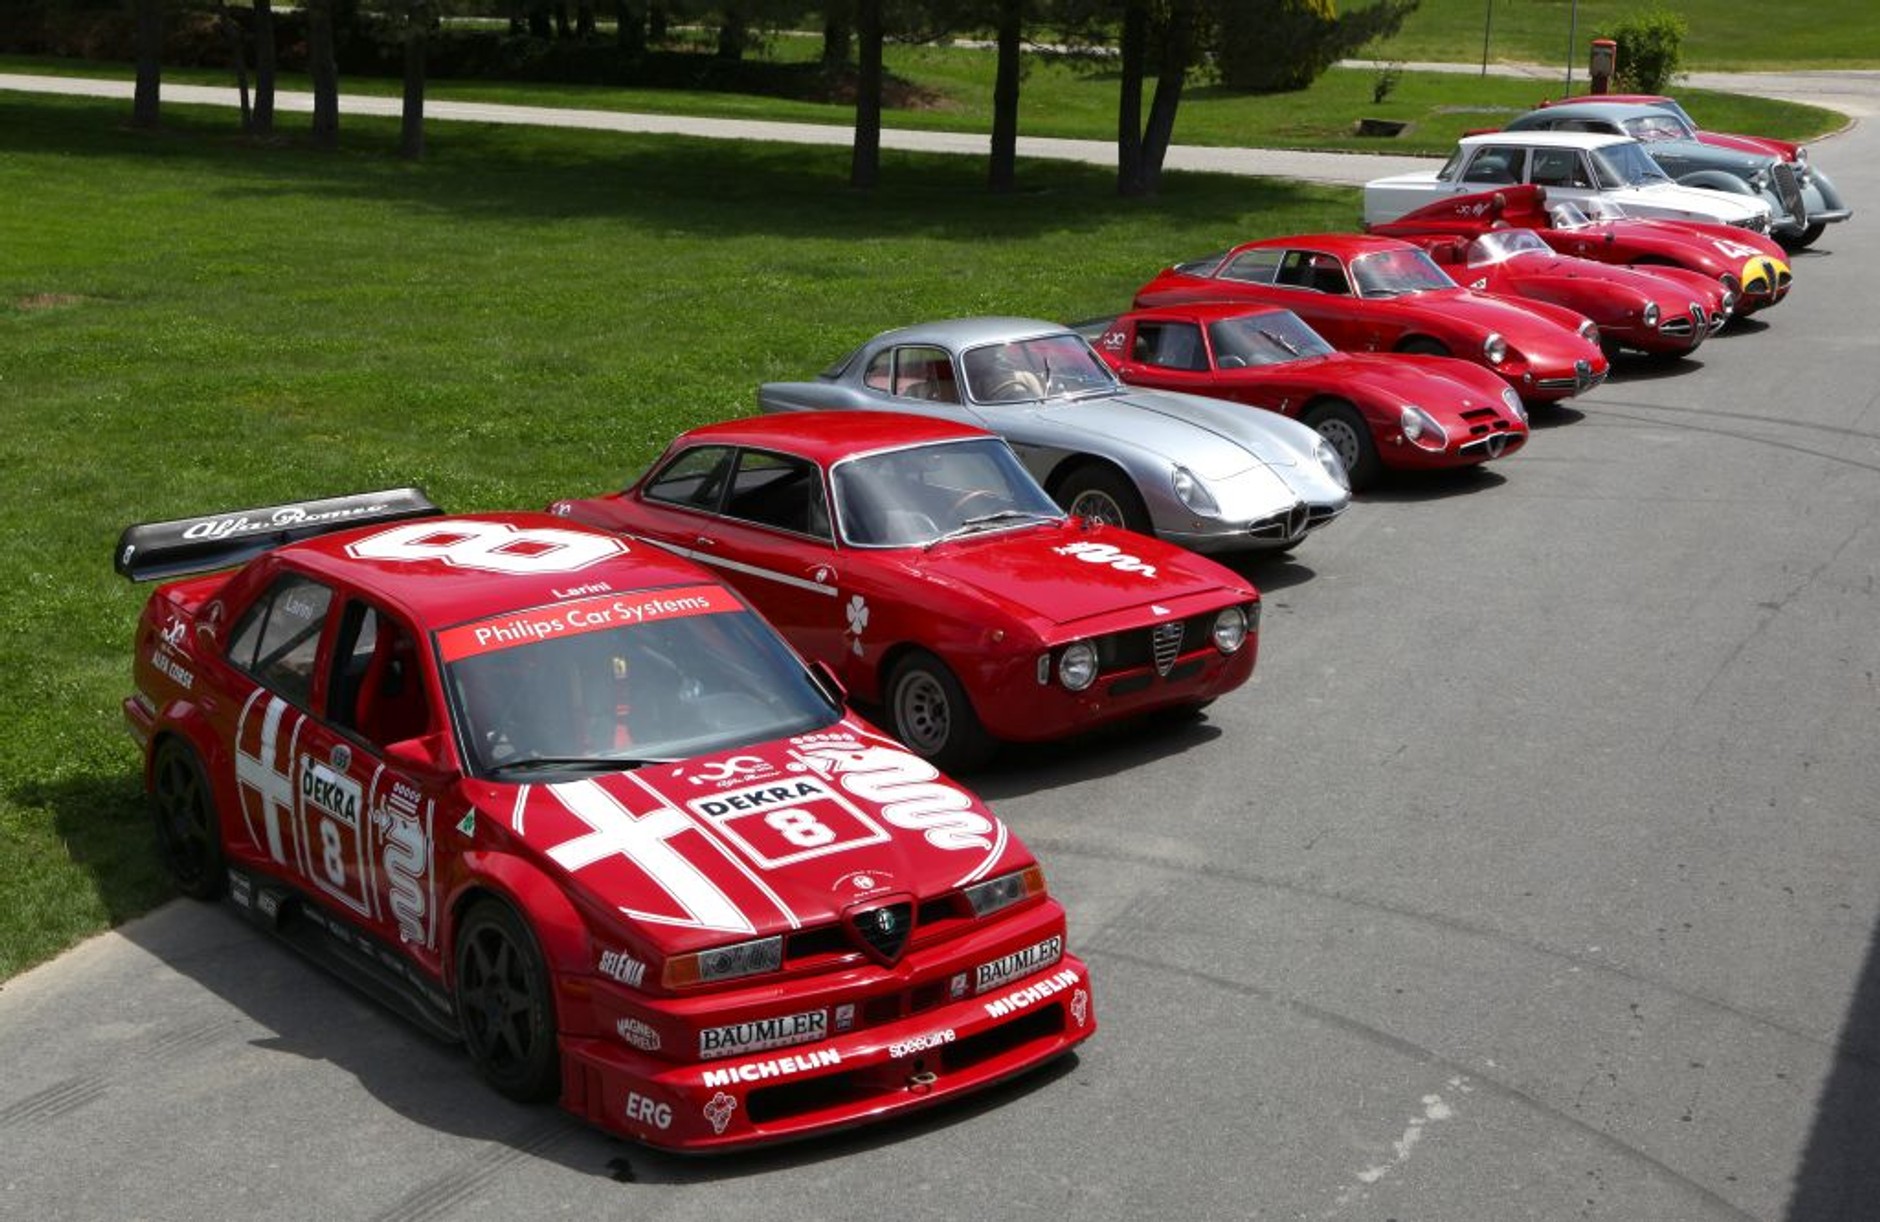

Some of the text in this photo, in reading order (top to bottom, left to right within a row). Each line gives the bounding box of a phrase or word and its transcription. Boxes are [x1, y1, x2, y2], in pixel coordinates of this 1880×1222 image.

[183, 508, 388, 539] Alfa Romeo
[123, 545, 135, 565] 8
[345, 520, 630, 575] 8
[552, 581, 611, 599] Larini
[475, 596, 710, 646] Philips Car Systems
[303, 769, 356, 823] DEKRA
[700, 782, 822, 818] DEKRA
[763, 808, 836, 848] 8
[319, 816, 346, 887] 8
[983, 969, 1080, 1018] MICHELIN
[702, 1048, 842, 1088] MICHELIN
[626, 1092, 672, 1129] ERG
